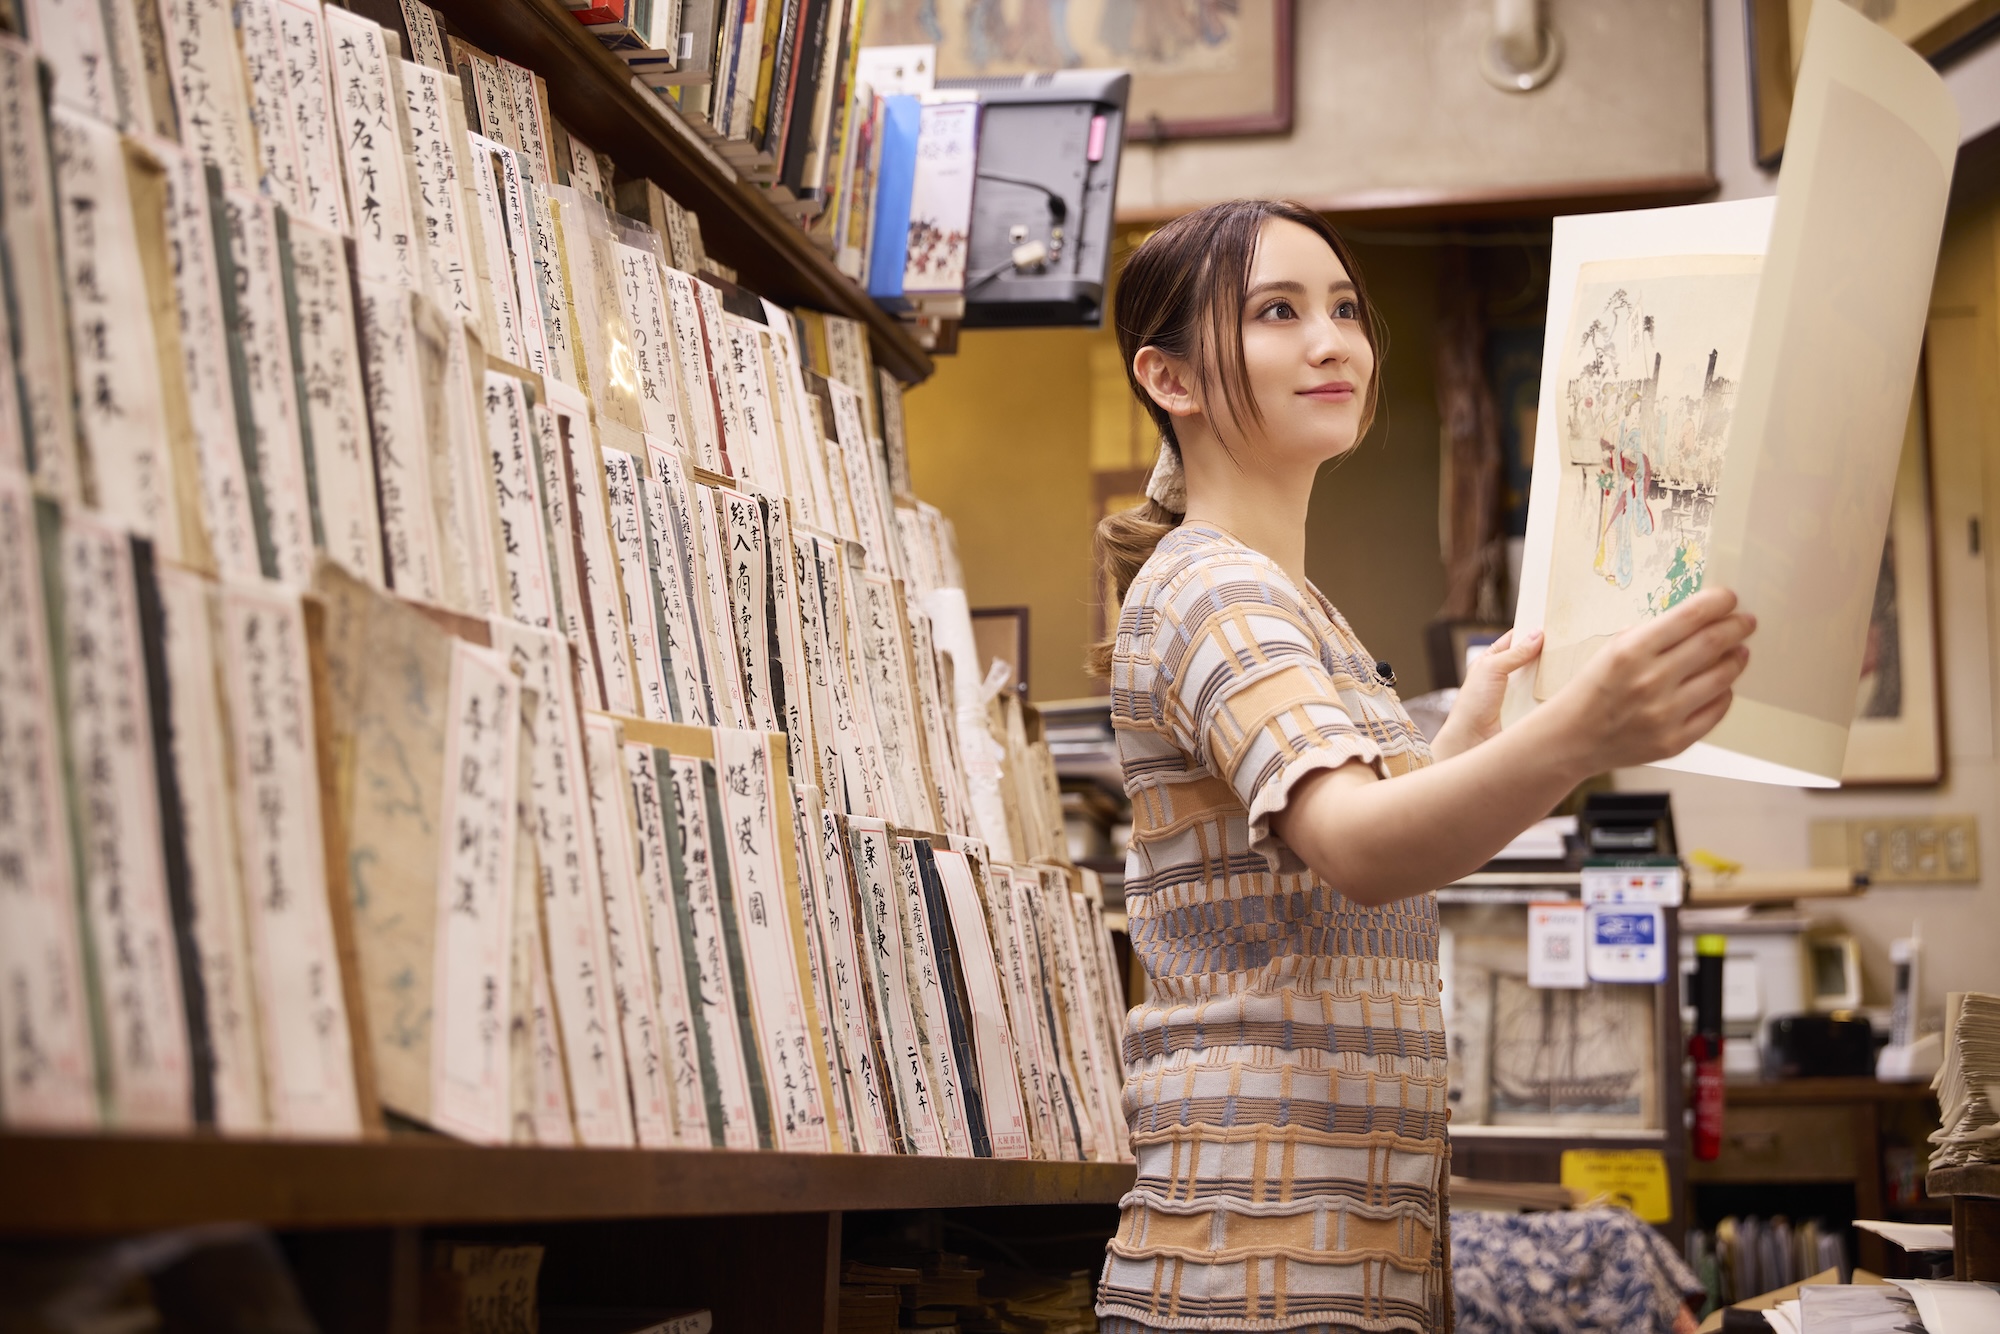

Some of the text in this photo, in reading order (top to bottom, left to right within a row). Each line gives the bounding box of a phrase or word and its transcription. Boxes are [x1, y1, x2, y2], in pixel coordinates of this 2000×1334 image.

[419, 71, 440, 133] 加藤弘之
[621, 255, 661, 404] ばけもの屋敷
[907, 1046, 927, 1114] 二万九千
[940, 1052, 957, 1119] 三万八千
